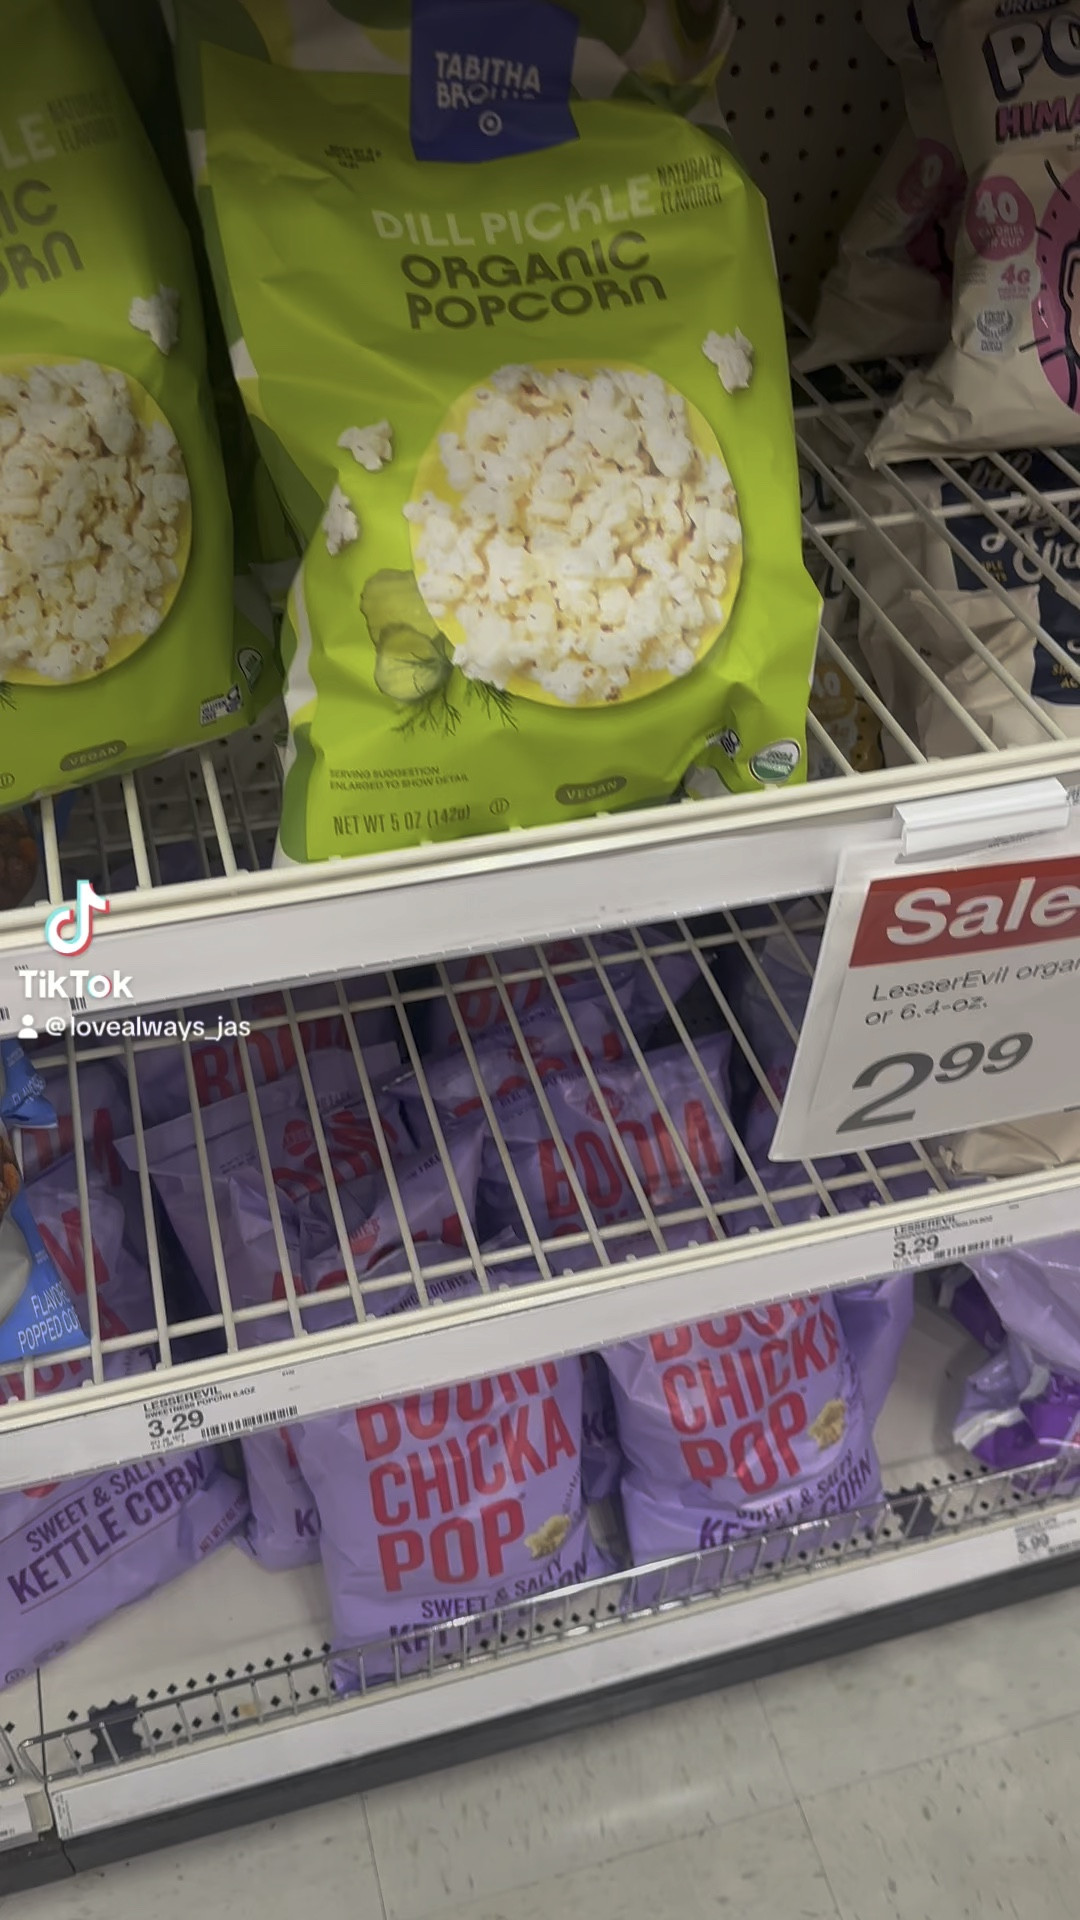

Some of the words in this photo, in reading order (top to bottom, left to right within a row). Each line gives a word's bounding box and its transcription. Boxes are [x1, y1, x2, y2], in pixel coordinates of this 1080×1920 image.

[435, 51, 542, 94] TABITHA
[436, 81, 536, 110] BRO
[371, 208, 476, 247] DILL
[480, 174, 657, 245] PICKLE
[974, 191, 1019, 225] 40
[401, 230, 650, 289] ORGANIC
[406, 274, 667, 330] POPCORN
[385, 780, 400, 789] TO
[565, 780, 618, 801] VEGAN
[333, 815, 359, 836] NET
[363, 813, 385, 834] WT
[390, 812, 400, 832] 5
[404, 811, 422, 831] OZ
[886, 876, 1080, 946] Sale
[872, 965, 1009, 1002] LesserEvil
[865, 1009, 893, 1026] or
[900, 995, 988, 1020] 6.4-oz.
[893, 1234, 939, 1258] 3.29
[17, 1315, 63, 1353] POPPED
[662, 1308, 840, 1435] CHICKA
[143, 1386, 219, 1412] LESSEREVIL
[147, 1409, 204, 1438] 3.29
[369, 1396, 577, 1527] CHICKA
[6, 1503, 128, 1605] KETTLE
[124, 1449, 206, 1527] CORN
[26, 1496, 88, 1552] SWEET
[94, 1485, 112, 1508] &
[377, 1498, 526, 1592] POP
[421, 1595, 489, 1619] SWEET
